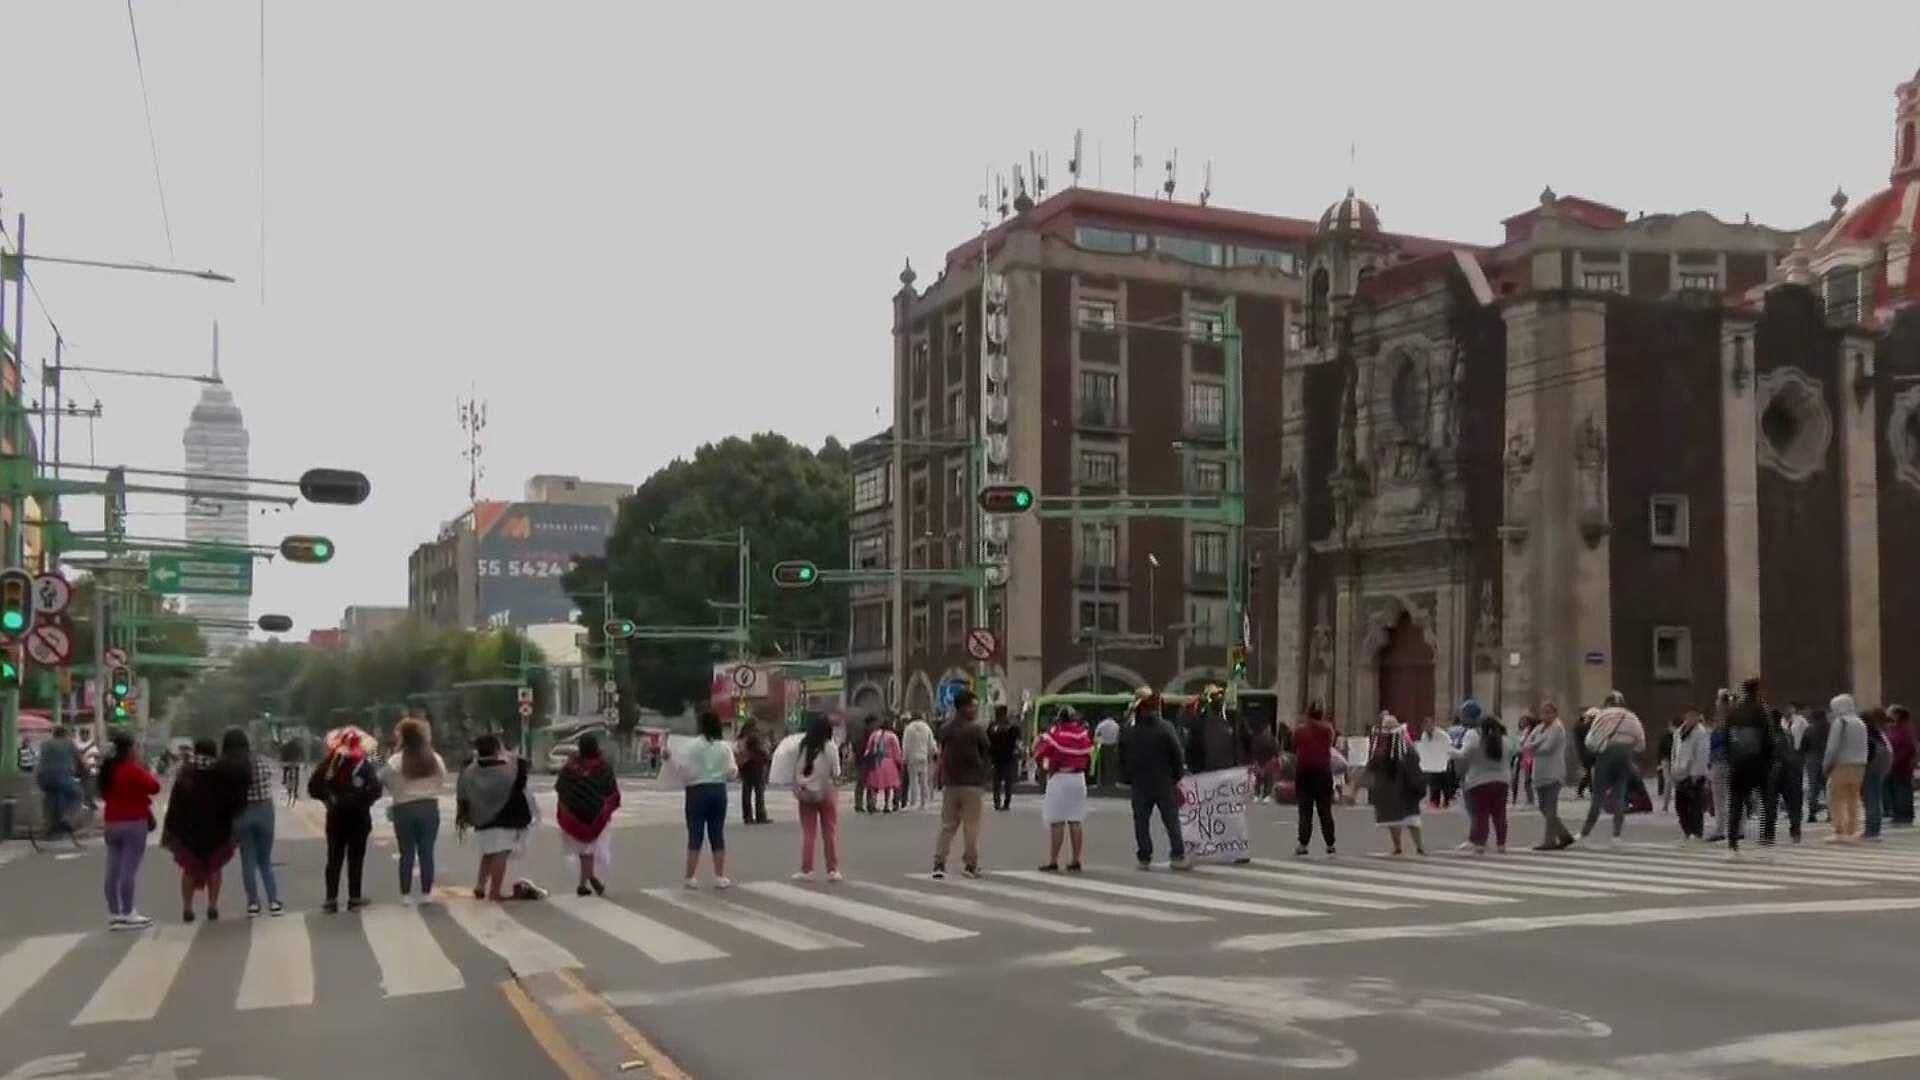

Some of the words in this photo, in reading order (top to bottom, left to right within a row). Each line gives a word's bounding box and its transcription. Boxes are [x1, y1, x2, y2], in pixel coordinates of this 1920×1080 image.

[478, 559, 501, 577] 55
[508, 559, 564, 578] 5424
[1198, 814, 1226, 840] NO
